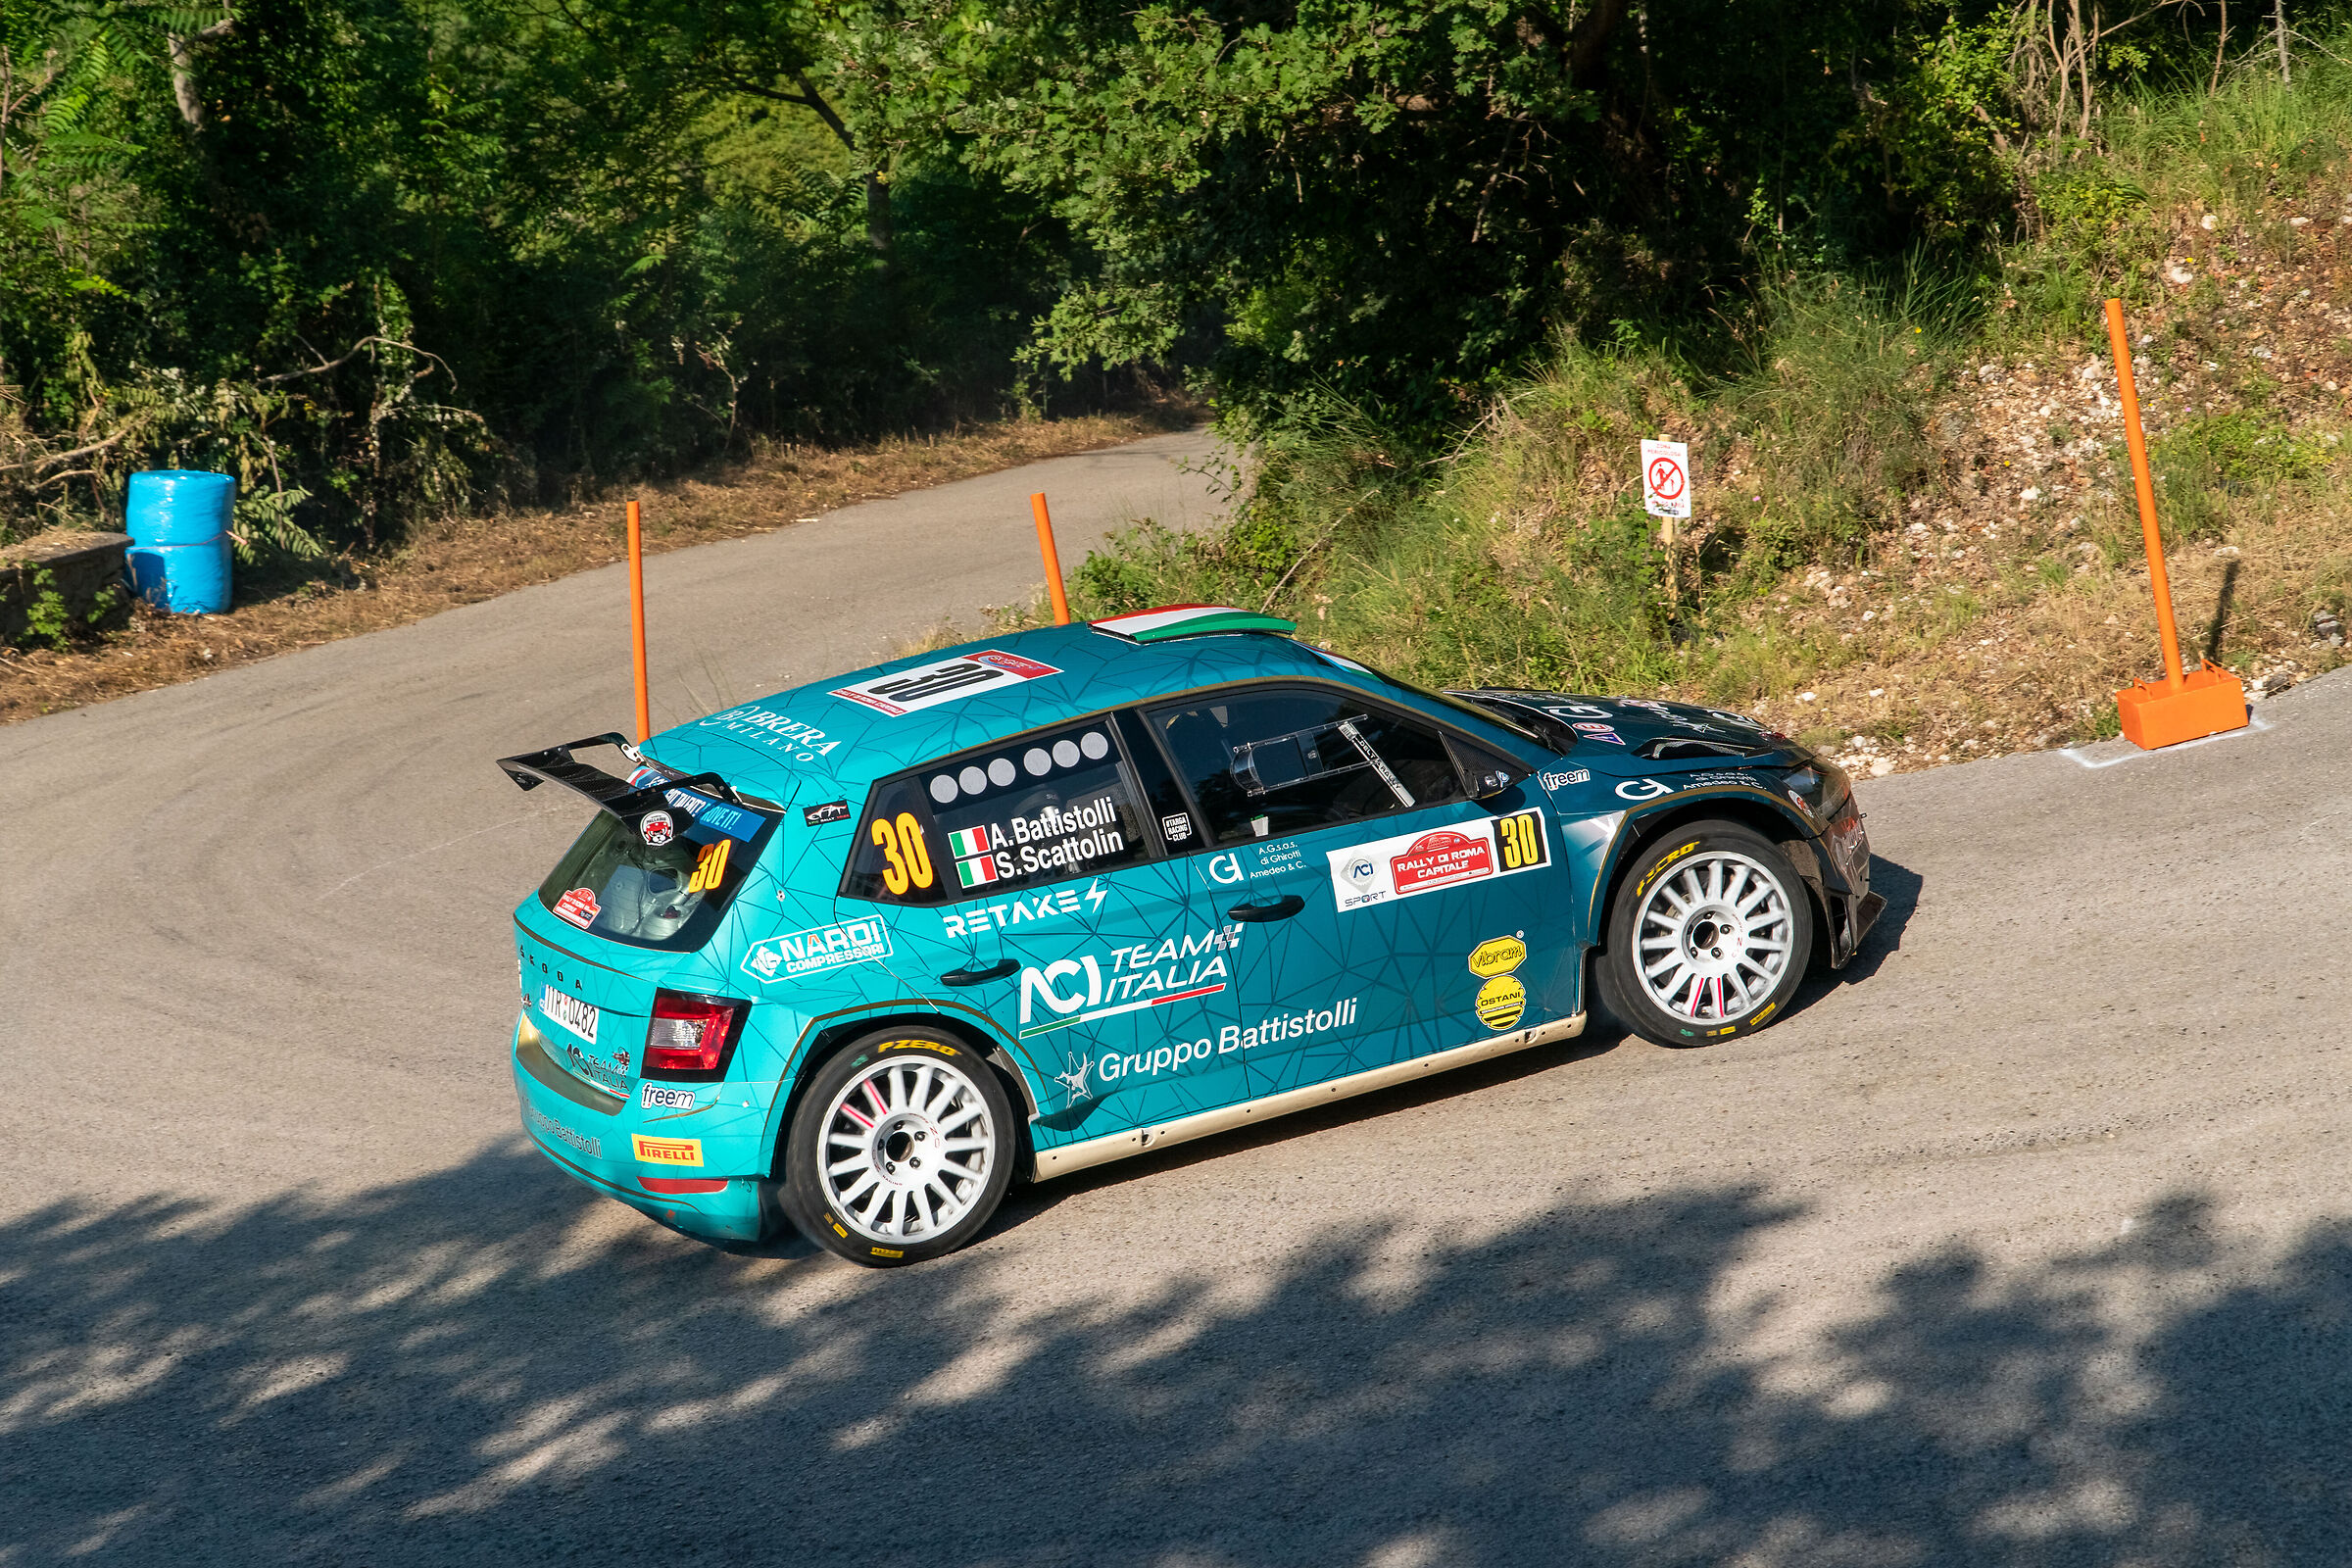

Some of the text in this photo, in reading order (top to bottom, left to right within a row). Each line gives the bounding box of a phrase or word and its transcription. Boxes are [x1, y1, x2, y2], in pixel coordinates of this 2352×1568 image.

[722, 721, 814, 762] MILANO
[742, 710, 842, 757] BRERA
[1545, 769, 1590, 789] freem
[1168, 824, 1188, 835] RACING
[1173, 832, 1187, 841] CLUB
[1500, 813, 1539, 868] 30
[689, 838, 732, 894] 30
[871, 812, 934, 895] 30
[1270, 850, 1301, 863] Ghirotti
[1396, 846, 1486, 872] RALLY DI ROMA
[1250, 866, 1287, 879] Amedeo
[1417, 859, 1469, 878] CAPITALE
[1345, 891, 1386, 906] SPORT
[943, 889, 1082, 939] RETAKE
[779, 921, 882, 961] NARDI
[1109, 929, 1215, 973] TEAM
[786, 943, 885, 973] COMPRESSORI
[1472, 945, 1523, 968] vibram
[1104, 956, 1228, 1004] ITALIA
[1481, 991, 1521, 1006] OSTANI
[568, 997, 596, 1039] 0482
[1099, 998, 1358, 1081] Gruppo Battistolli
[588, 1054, 619, 1074] TEAM
[593, 1069, 630, 1092] ITALIA
[643, 1084, 694, 1106] freem
[554, 1117, 603, 1159] Battistolli
[639, 1141, 695, 1160] PIRELLI
